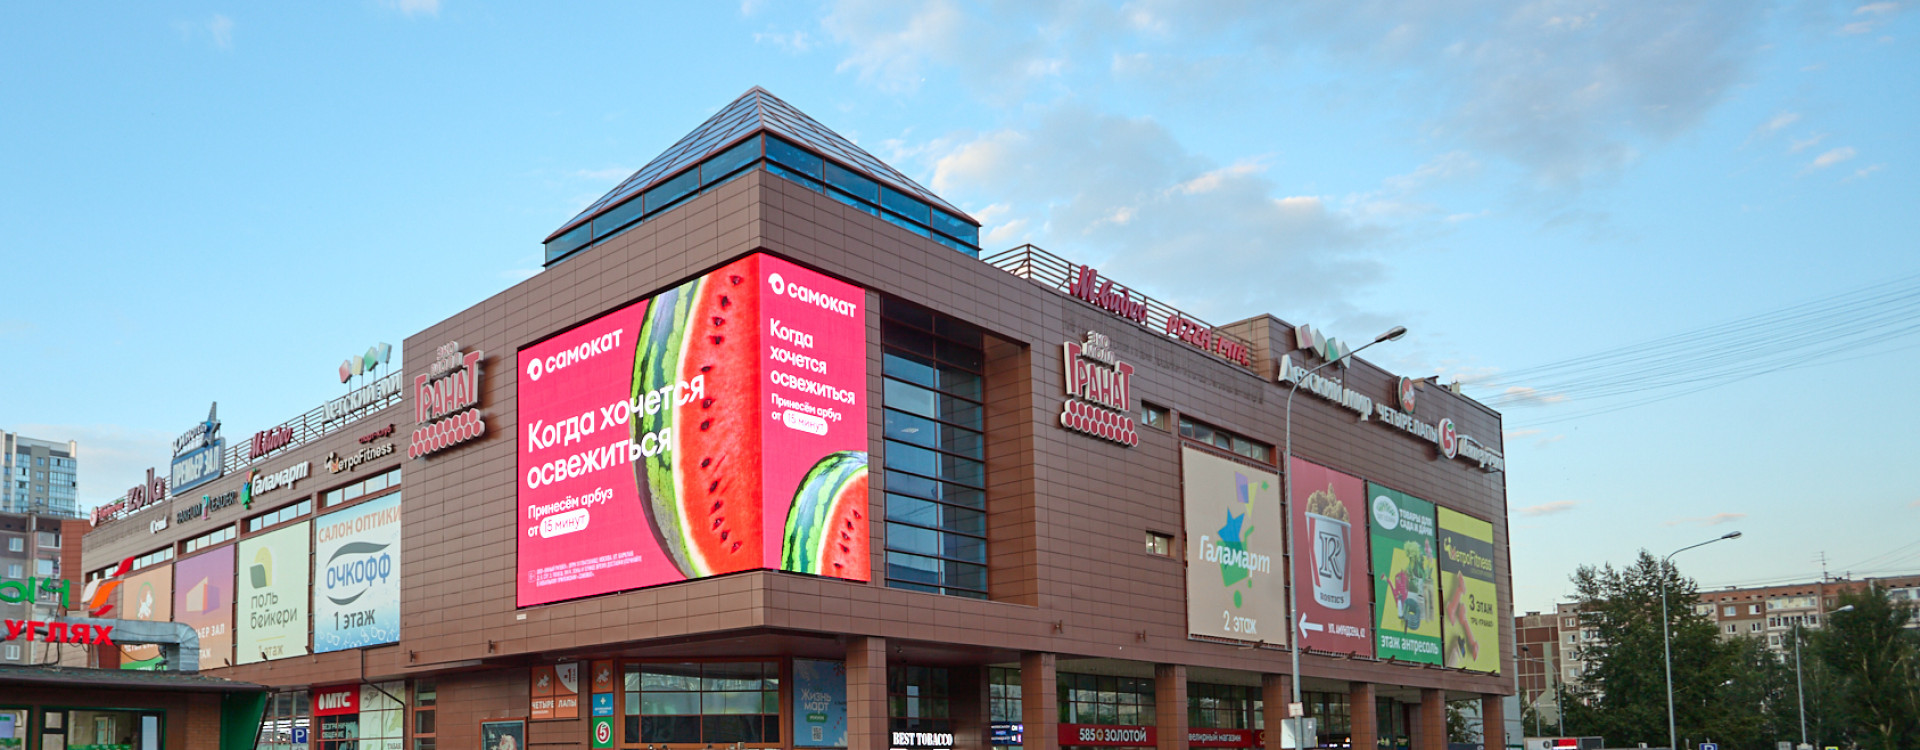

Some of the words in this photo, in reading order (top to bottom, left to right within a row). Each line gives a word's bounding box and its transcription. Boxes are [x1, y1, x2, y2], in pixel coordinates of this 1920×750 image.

[787, 282, 857, 317] самокат
[1070, 265, 1148, 322] М.видео
[770, 318, 814, 349] Когда
[1087, 330, 1110, 350] ЭКО
[1167, 314, 1212, 350] PIZZA
[437, 341, 459, 360] ЭКО
[545, 329, 623, 374] самокат
[770, 346, 827, 375] хочется
[415, 350, 484, 425] ГРАНАТ
[770, 370, 856, 405] освежиться
[1064, 341, 1135, 412] ГРАНАТ
[1278, 354, 1343, 403] Детский
[1342, 388, 1373, 421] мир
[321, 384, 378, 422] Детский
[379, 372, 403, 399] ми
[771, 393, 816, 414] Принесём
[816, 407, 842, 422] арбуз
[528, 411, 595, 453] Когда
[600, 374, 705, 431] хочется
[771, 411, 782, 421] от
[787, 413, 796, 424] 15
[798, 418, 824, 433] минут
[1376, 402, 1413, 432] ЧЕТЫРЕ
[1412, 419, 1438, 444] ЛАПЫ
[172, 452, 203, 489] ПРЕМЬЕР
[203, 445, 219, 476] ЗАЛ
[527, 427, 672, 489] освежиться
[128, 466, 166, 514] zolla
[251, 461, 310, 496] Галамарт
[528, 494, 579, 519] Принесём
[580, 487, 613, 509] арбуз
[318, 521, 353, 543] САЛОН
[355, 505, 401, 533] ОПТИКИ
[527, 524, 538, 538] от
[544, 519, 553, 532] 15
[554, 514, 586, 531] минут
[327, 552, 391, 590] ОЧКОФФ
[1199, 535, 1271, 578] Галамарт
[1319, 531, 1342, 580] R
[251, 592, 279, 609] поль
[1469, 593, 1475, 611] 3
[1476, 601, 1493, 614] ЭТАЖ
[5, 619, 114, 646] УГЛЯХ
[211, 623, 225, 637] ЗАЛ
[251, 608, 298, 629] бейкери
[334, 611, 339, 631] 1
[343, 609, 375, 630] этаж
[1223, 610, 1230, 631] 2
[1234, 617, 1257, 634] этаж
[1380, 635, 1401, 650] этаж
[1401, 637, 1440, 655] антресоль
[325, 692, 351, 709] МТС
[531, 700, 554, 709] ЧЕТЫРЕ
[558, 698, 577, 708] ЛАПЫ
[893, 732, 915, 746] BEST
[916, 732, 953, 746] TOBACCO
[1080, 728, 1095, 742] 585
[1105, 727, 1147, 742] ЗОЛОТОЙ
[1188, 731, 1219, 744] велирный
